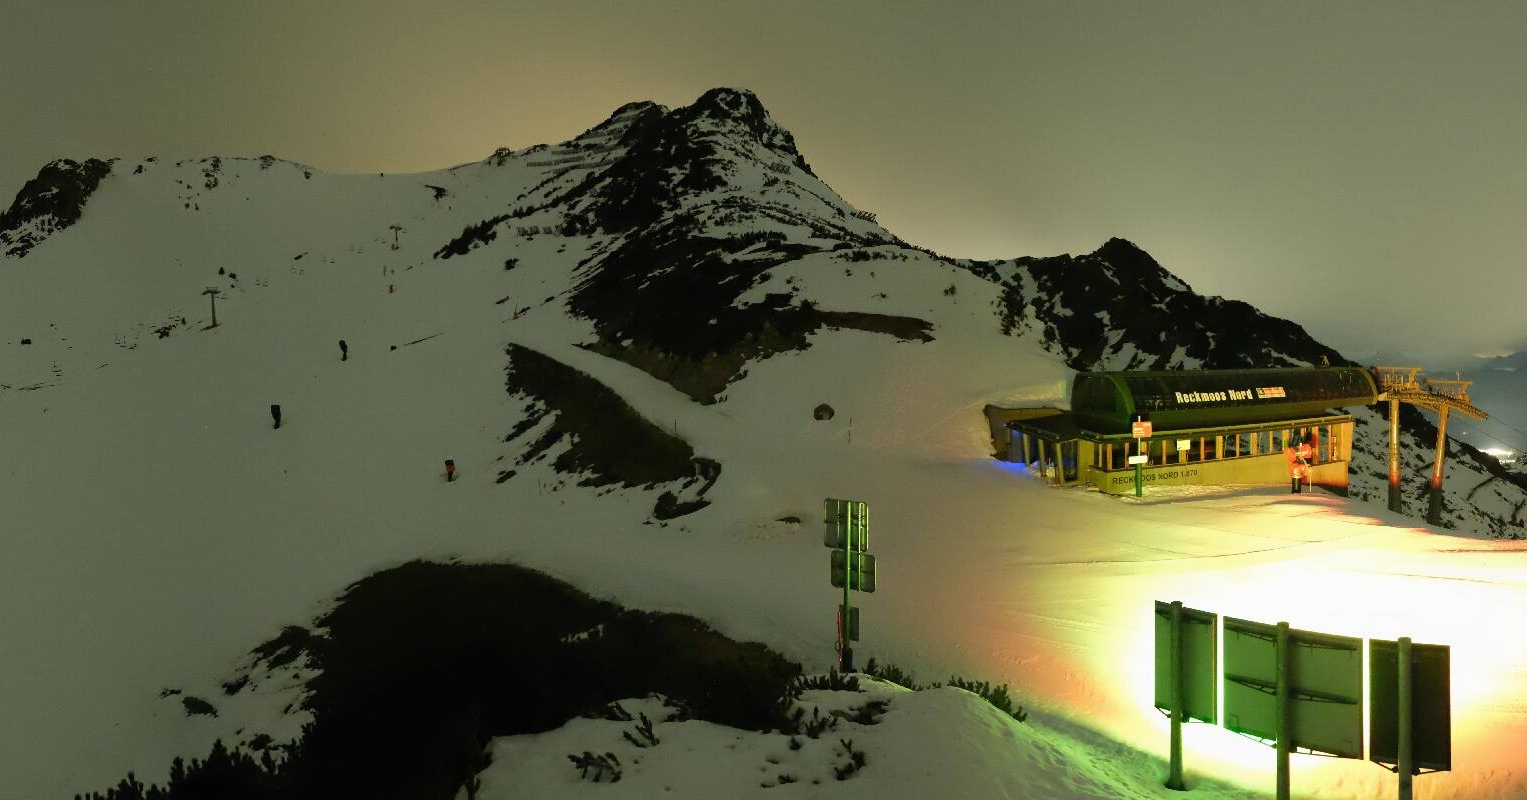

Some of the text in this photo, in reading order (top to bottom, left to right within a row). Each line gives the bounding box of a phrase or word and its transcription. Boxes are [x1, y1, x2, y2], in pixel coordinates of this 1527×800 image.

[1175, 391, 1227, 404] Reckmoos
[1228, 388, 1253, 401] Nord
[1113, 473, 1156, 484] RECKOOS
[1158, 471, 1179, 480] NORD
